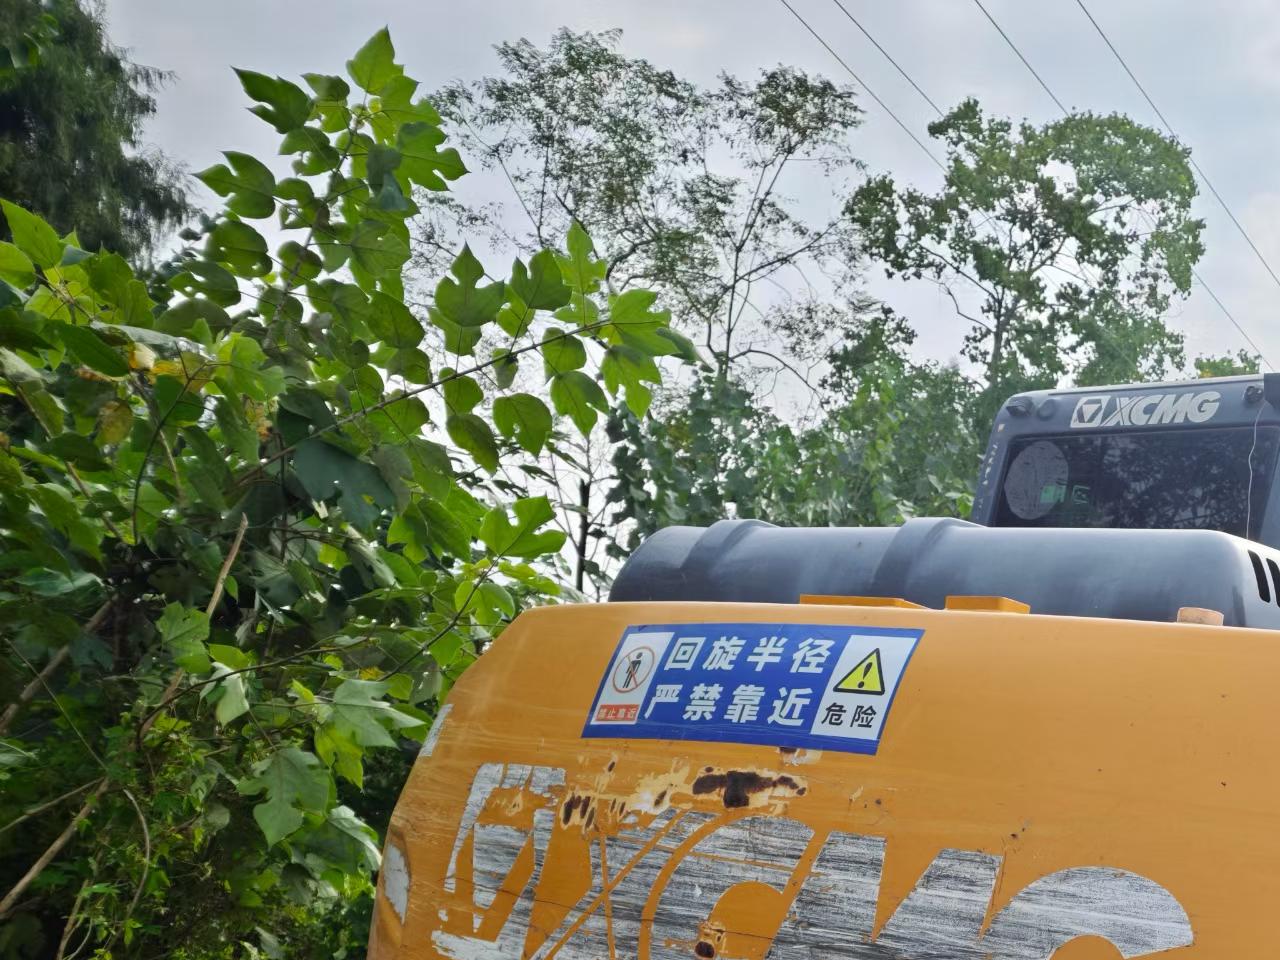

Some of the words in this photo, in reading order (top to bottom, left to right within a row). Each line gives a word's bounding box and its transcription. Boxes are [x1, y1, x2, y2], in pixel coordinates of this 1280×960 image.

[1102, 391, 1221, 427] XCMG
[663, 636, 836, 675] 回旋半径
[644, 682, 814, 727] 严禁靠近
[821, 703, 877, 729] 危险
